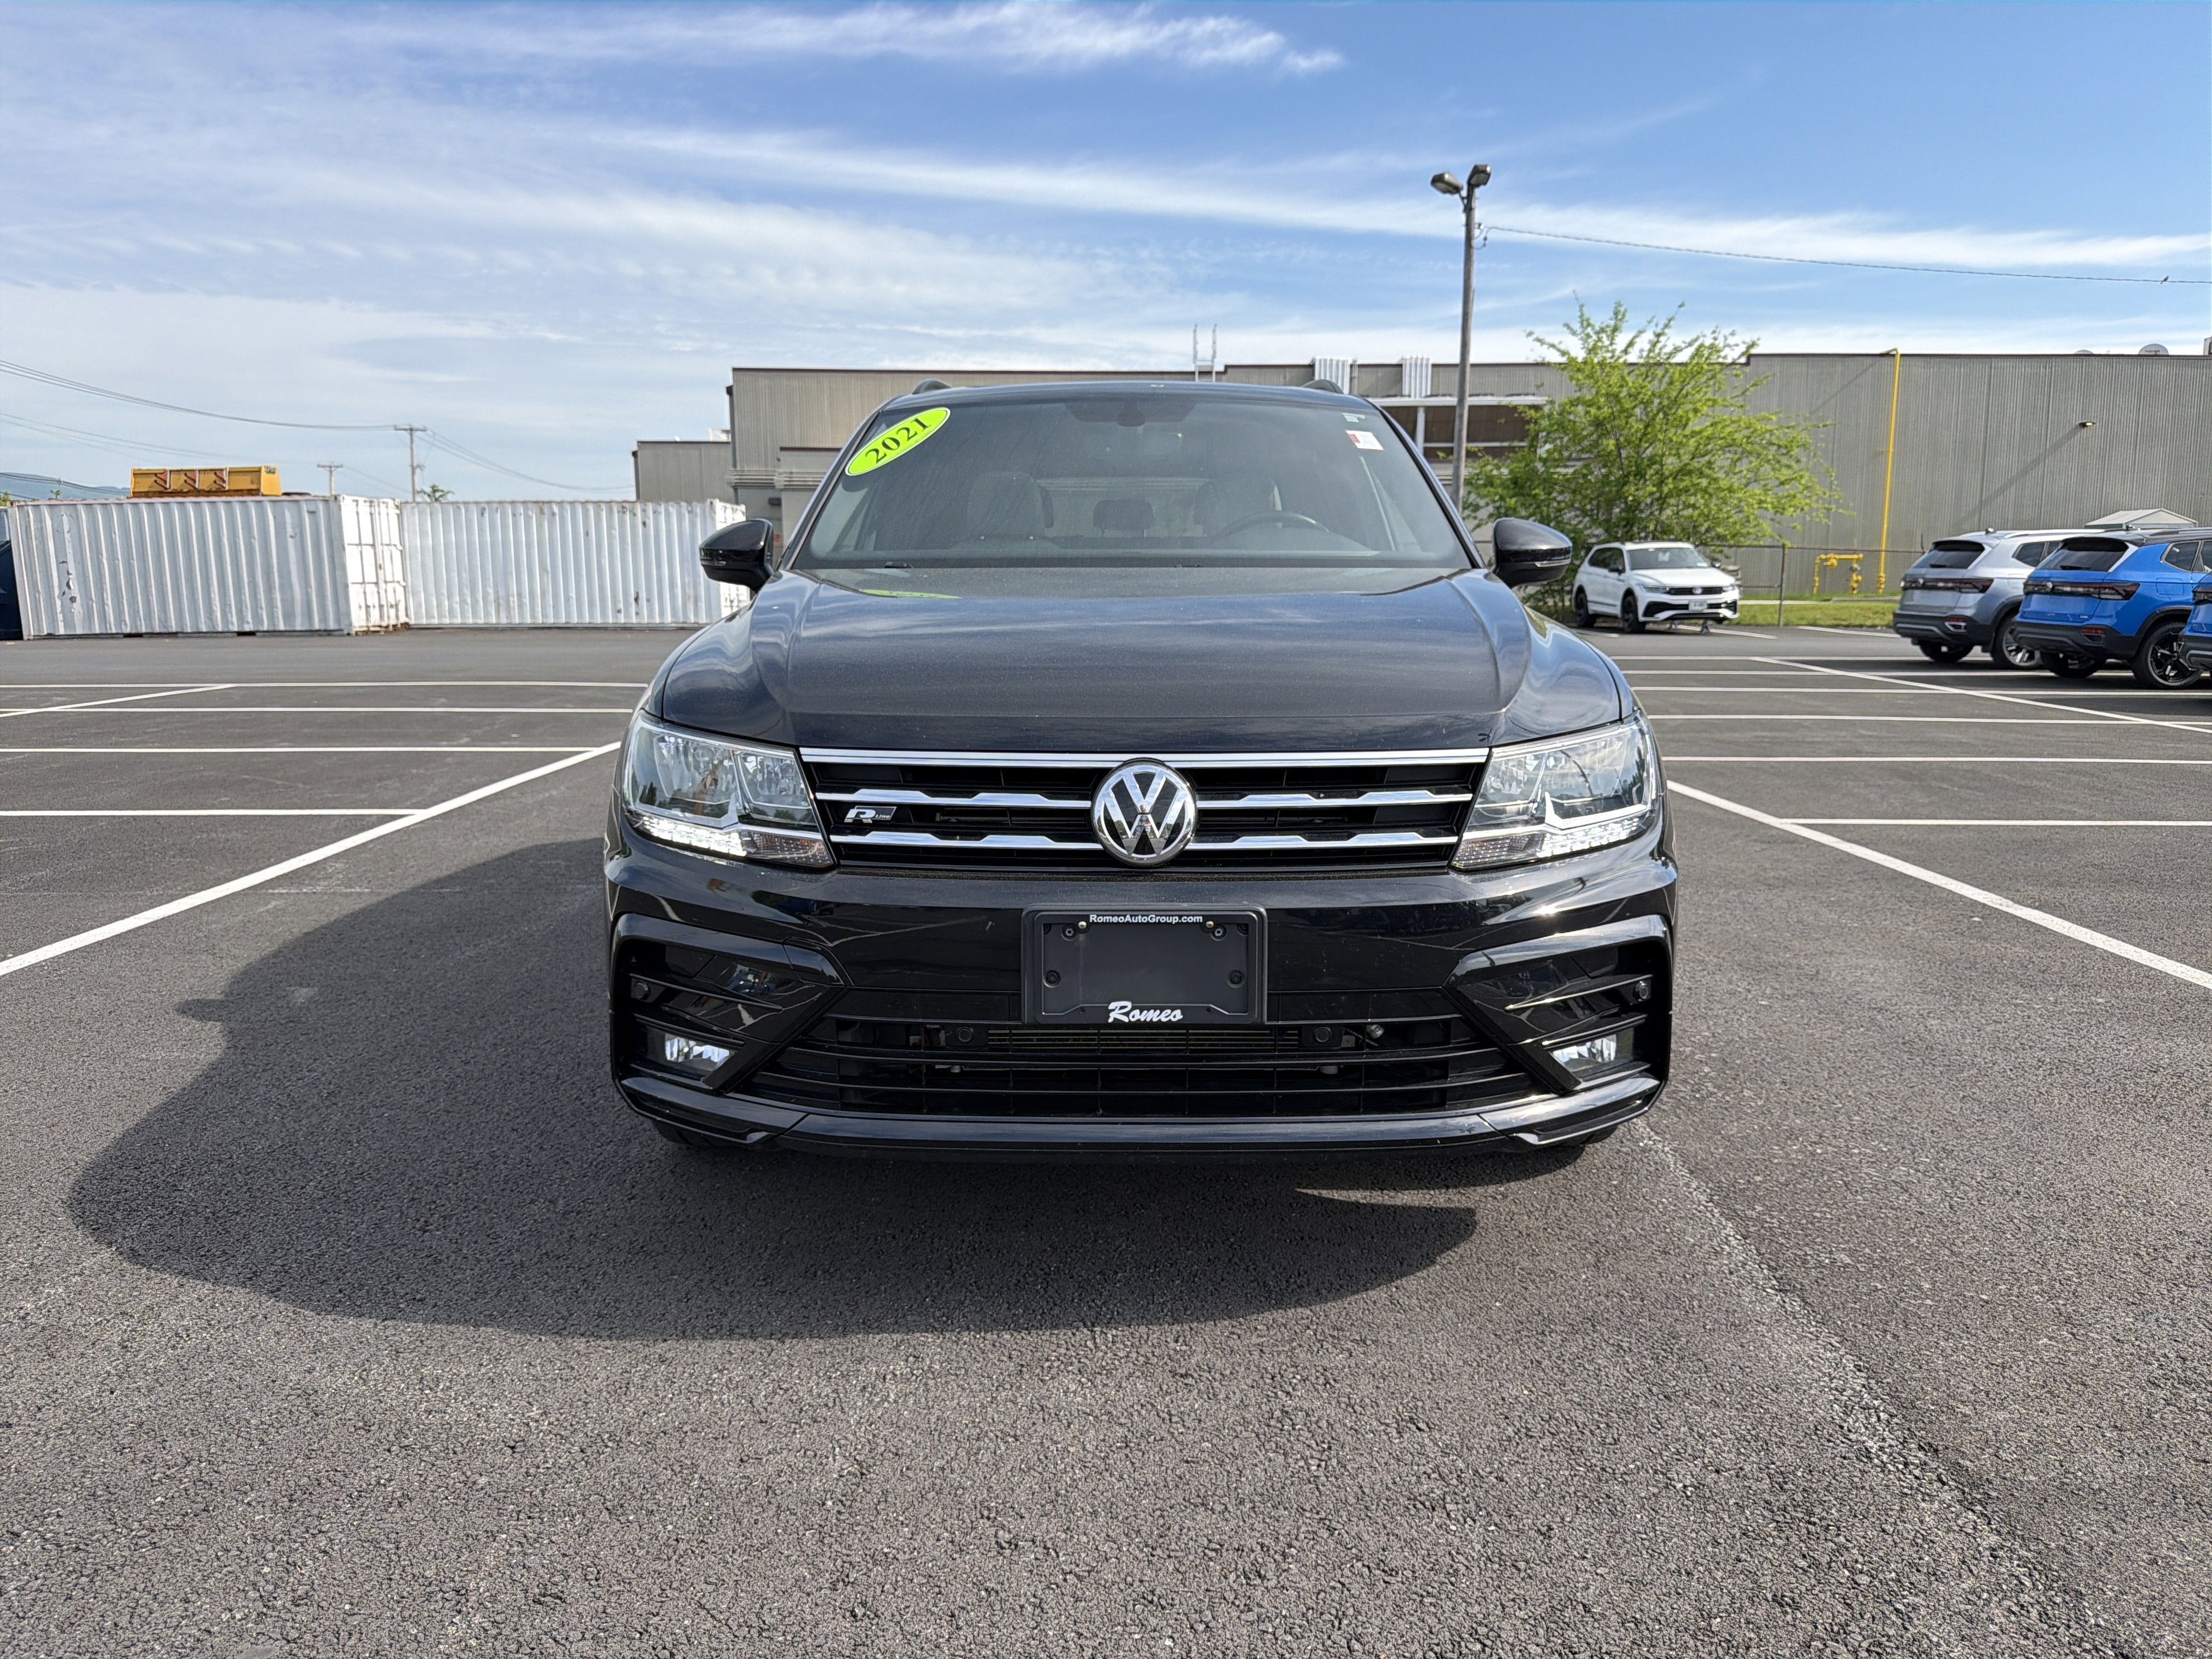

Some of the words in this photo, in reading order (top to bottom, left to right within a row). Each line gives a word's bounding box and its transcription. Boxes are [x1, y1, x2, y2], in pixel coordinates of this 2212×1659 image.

[865, 418, 932, 464] 2021
[1090, 915, 1203, 924] RomeoAutoGroup.com
[1108, 1001, 1183, 1023] Romeo
